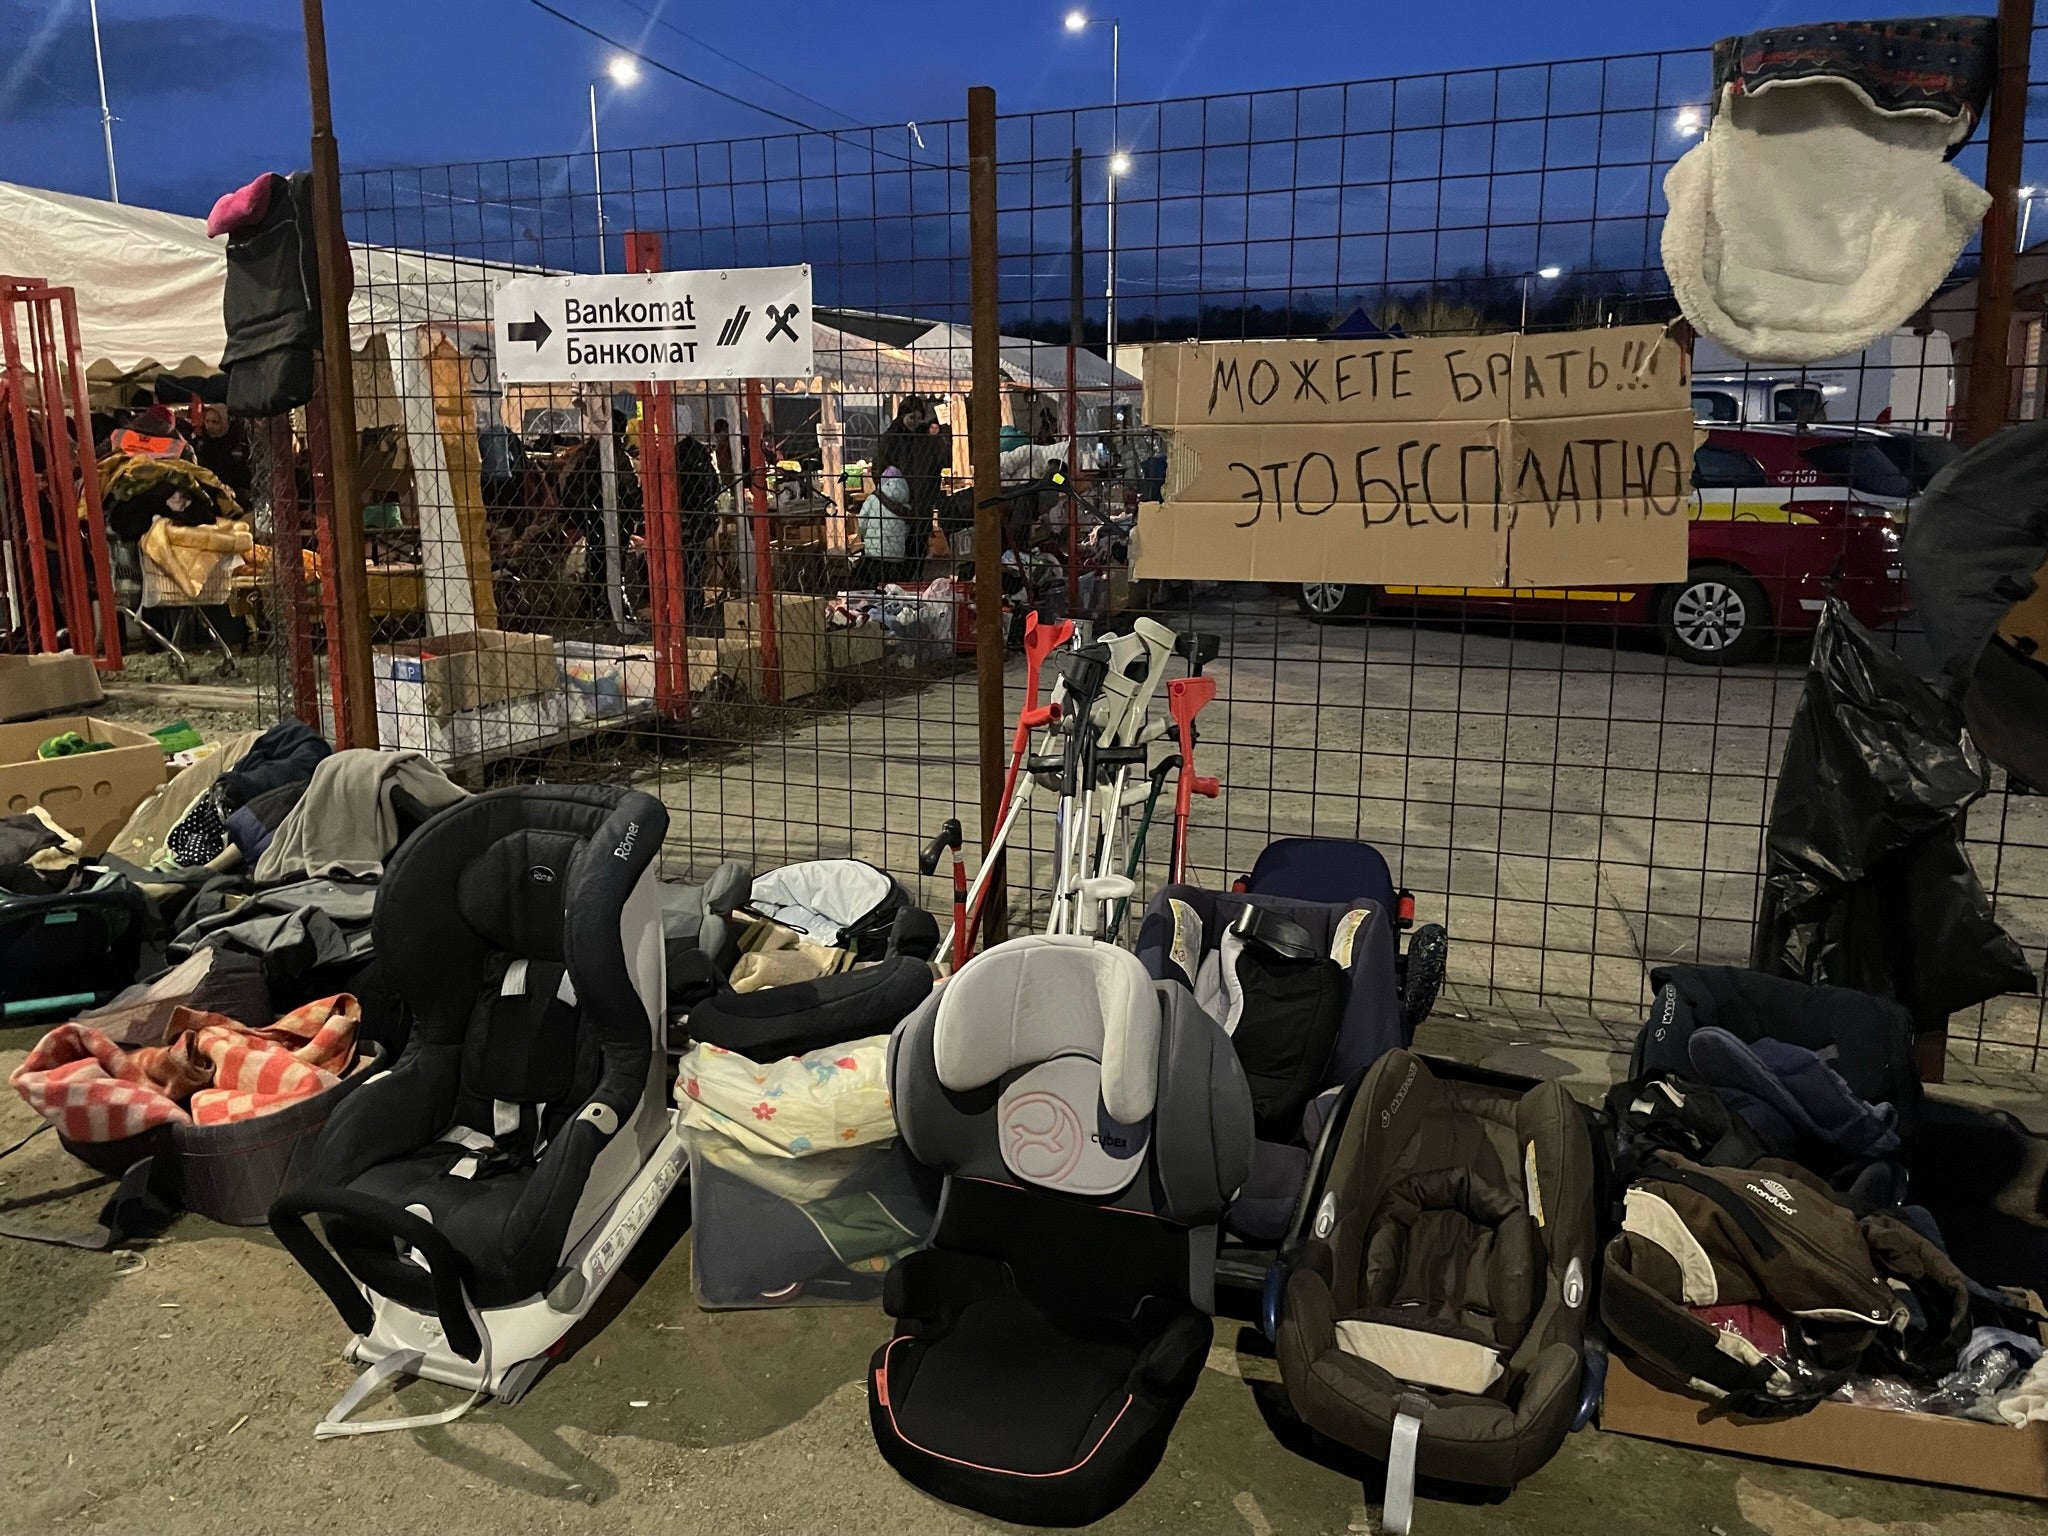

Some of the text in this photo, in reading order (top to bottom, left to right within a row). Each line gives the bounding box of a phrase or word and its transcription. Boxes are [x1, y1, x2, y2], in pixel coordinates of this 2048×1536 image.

[565, 294, 696, 325] Bankomat
[566, 337, 698, 365] Банкомат
[1207, 347, 1414, 416] МОЖЕТЕ
[1227, 439, 1684, 532] ЭТО БЕСПЛАТНО
[1795, 470, 1817, 483] 150
[613, 821, 640, 861] Römer
[1091, 1131, 1127, 1149] cybex
